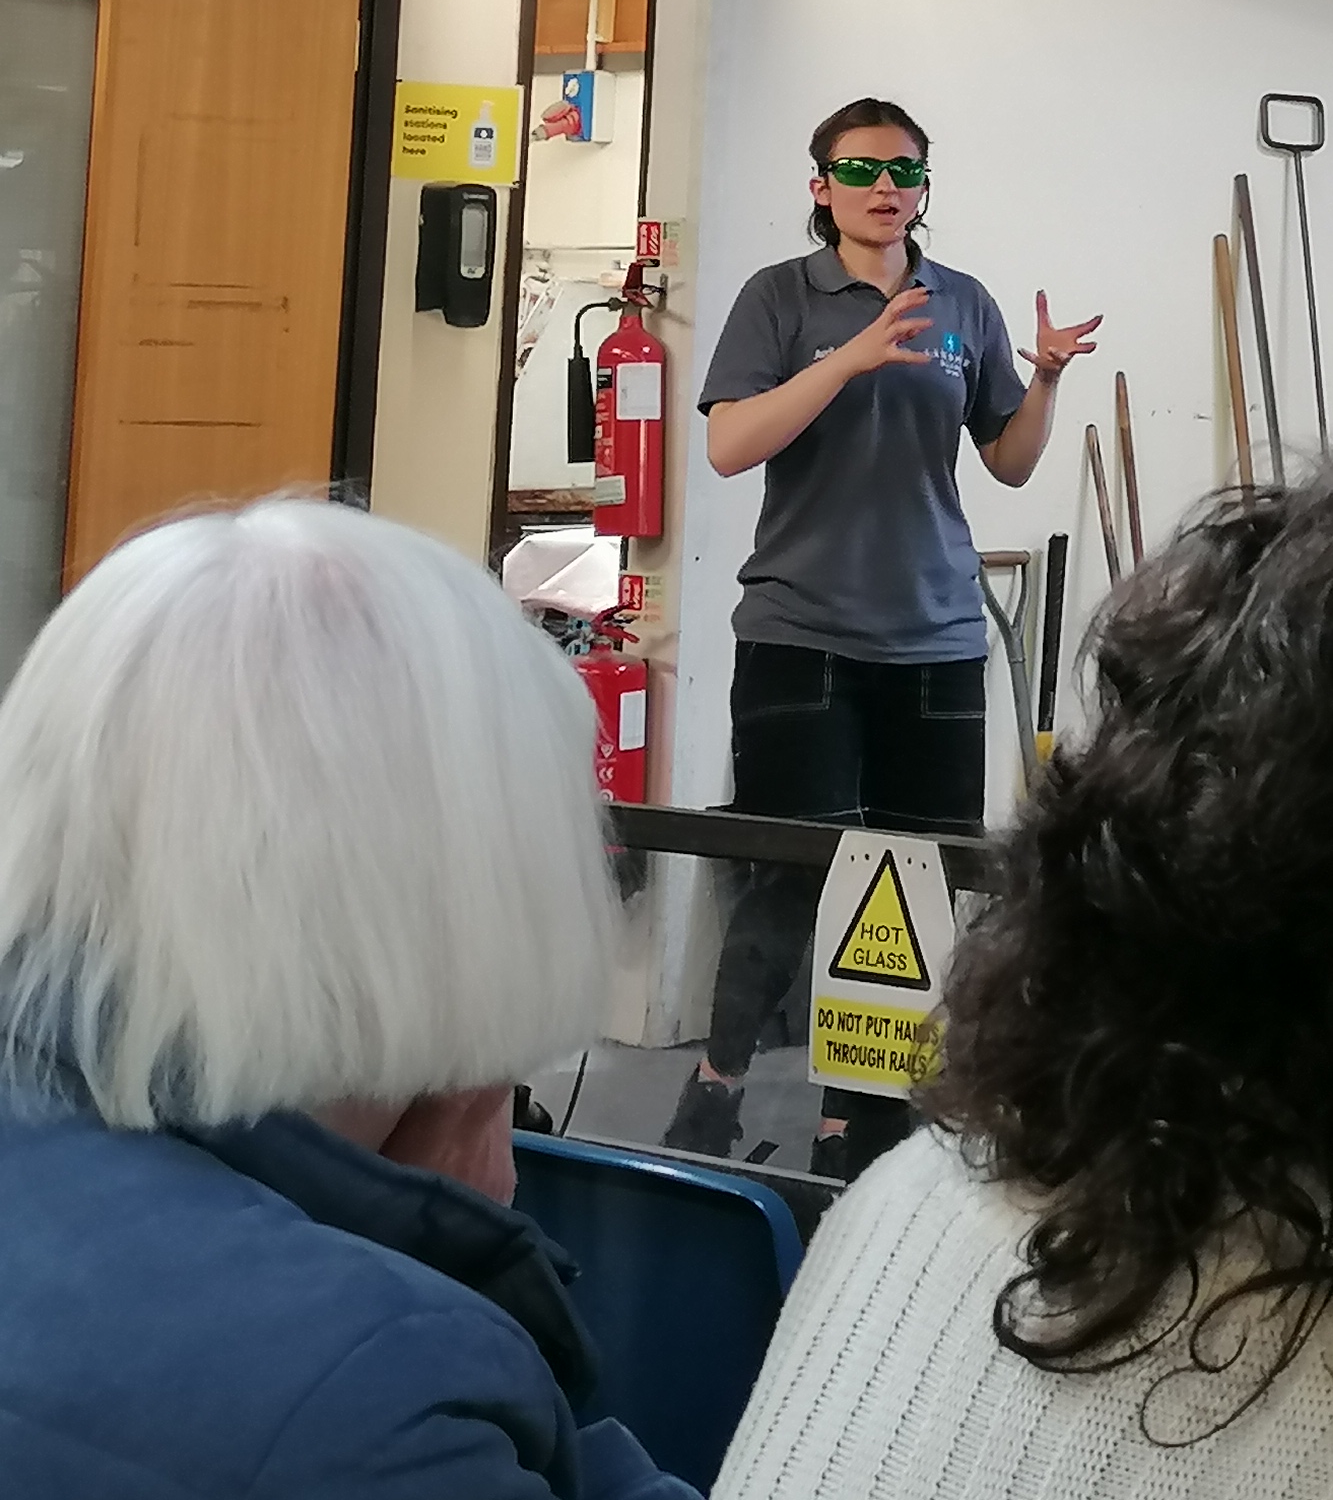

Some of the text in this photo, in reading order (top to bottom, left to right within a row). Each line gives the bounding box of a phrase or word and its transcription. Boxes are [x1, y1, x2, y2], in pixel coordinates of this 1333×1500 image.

[404, 104, 459, 119] Sanitising
[404, 118, 448, 130] stations
[402, 132, 445, 144] located
[402, 145, 427, 156] here
[860, 922, 904, 946] HOT
[853, 947, 908, 972] GLASS
[817, 1007, 835, 1029] DO
[837, 1011, 863, 1035] NOT
[865, 1015, 891, 1040] PUT
[826, 1039, 886, 1069] THROUGH
